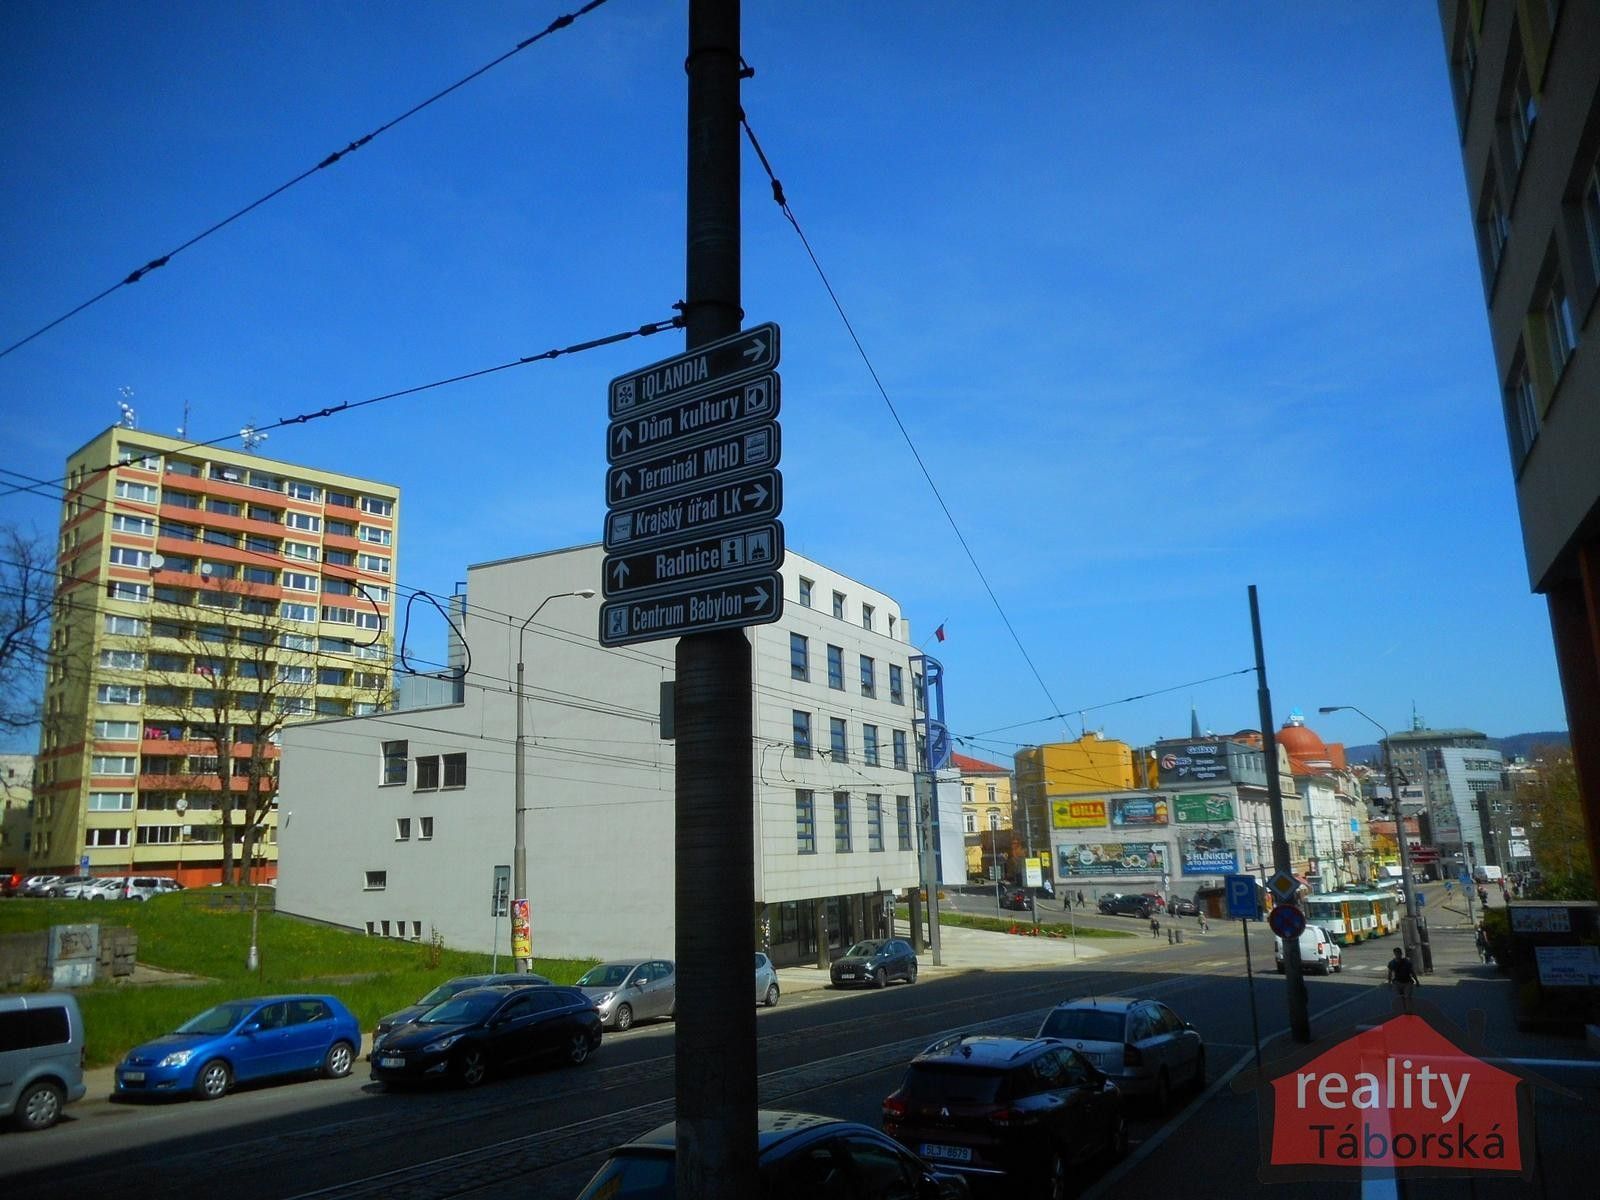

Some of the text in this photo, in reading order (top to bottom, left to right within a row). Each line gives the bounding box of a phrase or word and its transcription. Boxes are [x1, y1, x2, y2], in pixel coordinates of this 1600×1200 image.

[641, 355, 709, 400] iQLANDIA
[638, 395, 740, 444] Dům kultury
[638, 442, 740, 492] Terminál MHD
[635, 487, 743, 536] Krajský úřad LK
[656, 547, 720, 579] Radnice
[632, 592, 742, 631] Centrum Babylon
[1071, 803, 1104, 817] BILLA
[1231, 880, 1249, 906] P
